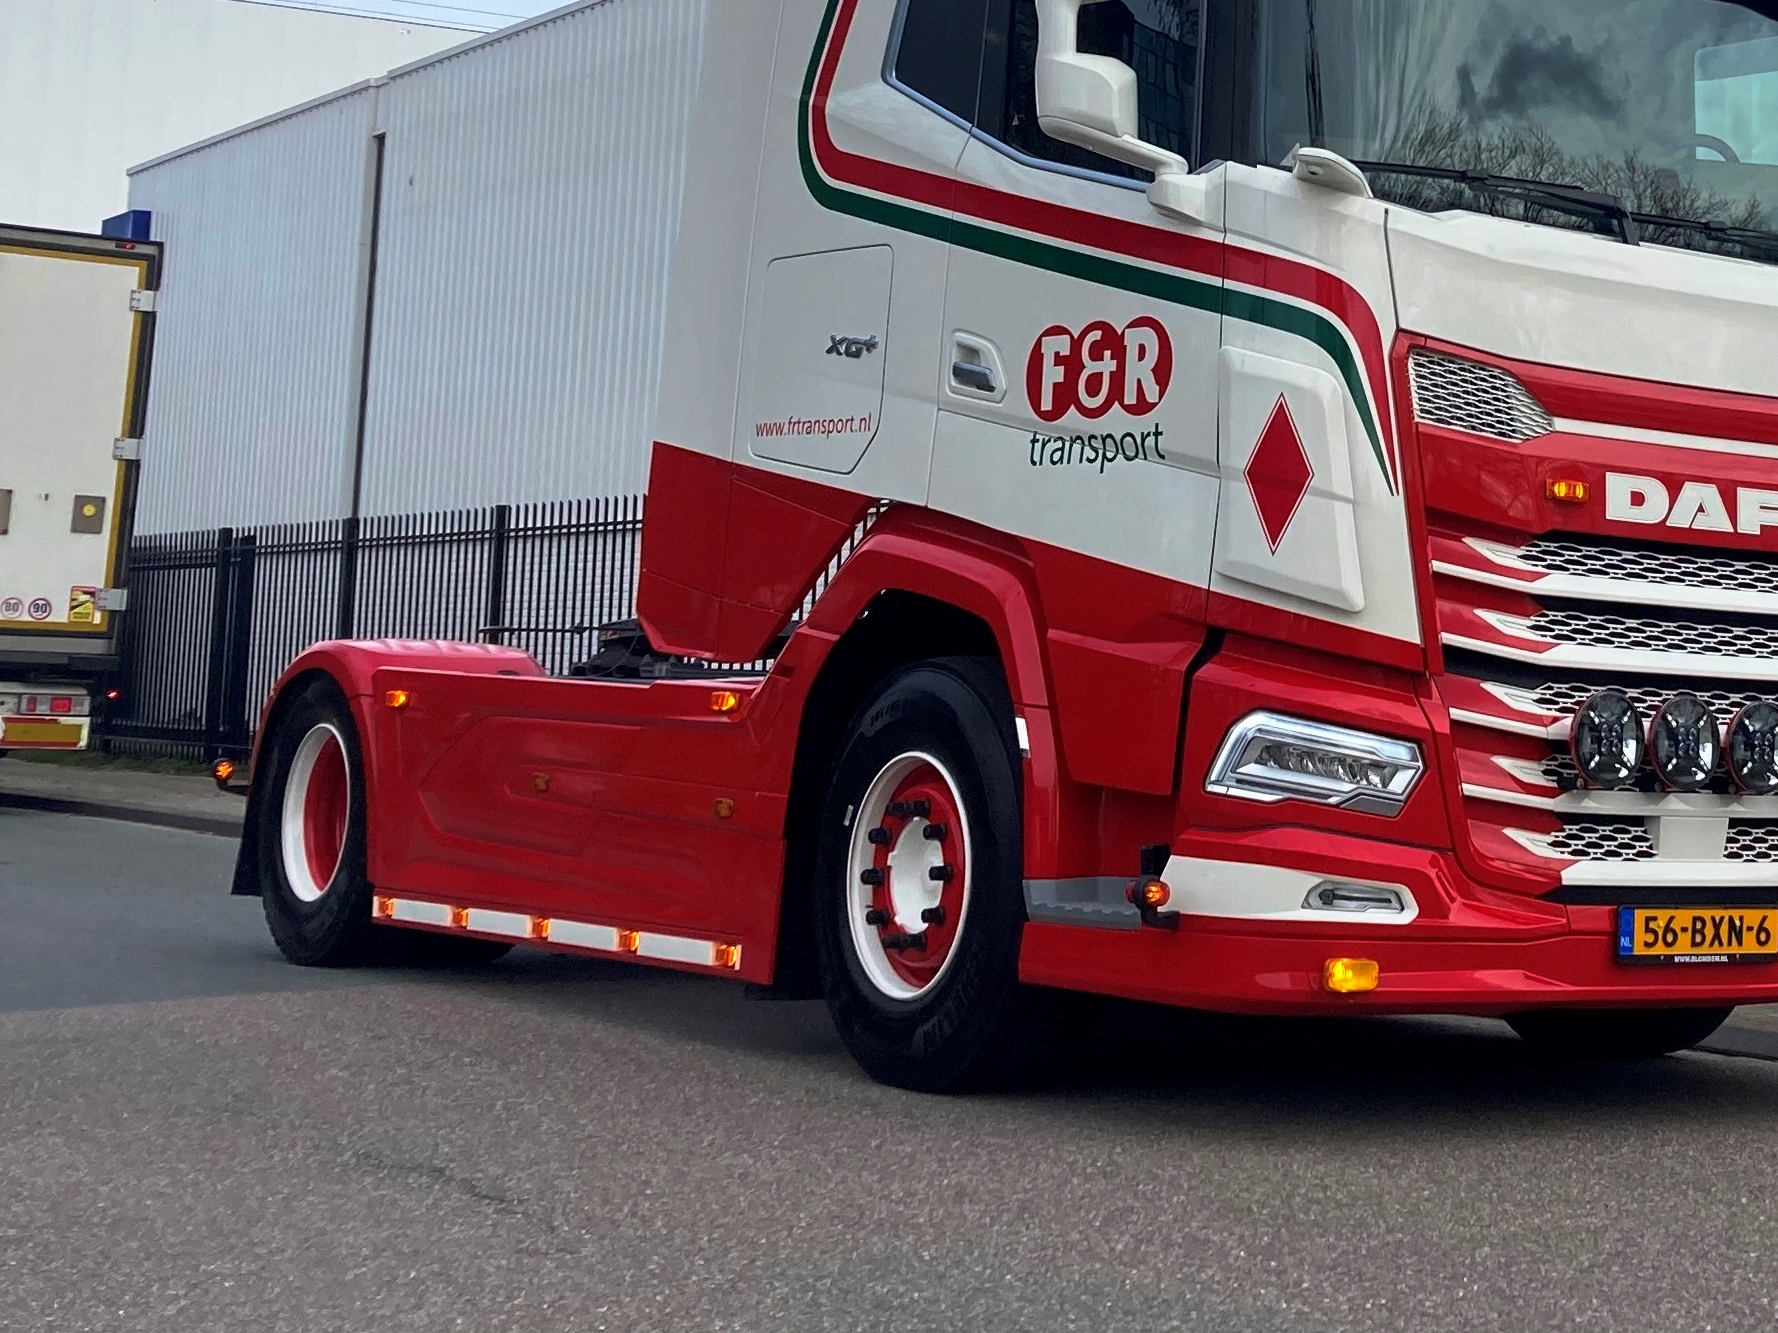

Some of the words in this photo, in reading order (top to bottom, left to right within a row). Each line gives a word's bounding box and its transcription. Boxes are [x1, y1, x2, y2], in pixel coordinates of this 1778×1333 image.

[1040, 326, 1161, 412] F&R
[755, 412, 872, 440] www.frtransport.nl
[1029, 422, 1166, 475] transport
[32, 602, 48, 614] 90
[1619, 936, 1633, 948] NL
[1642, 914, 1772, 949] 56-BXN-6
